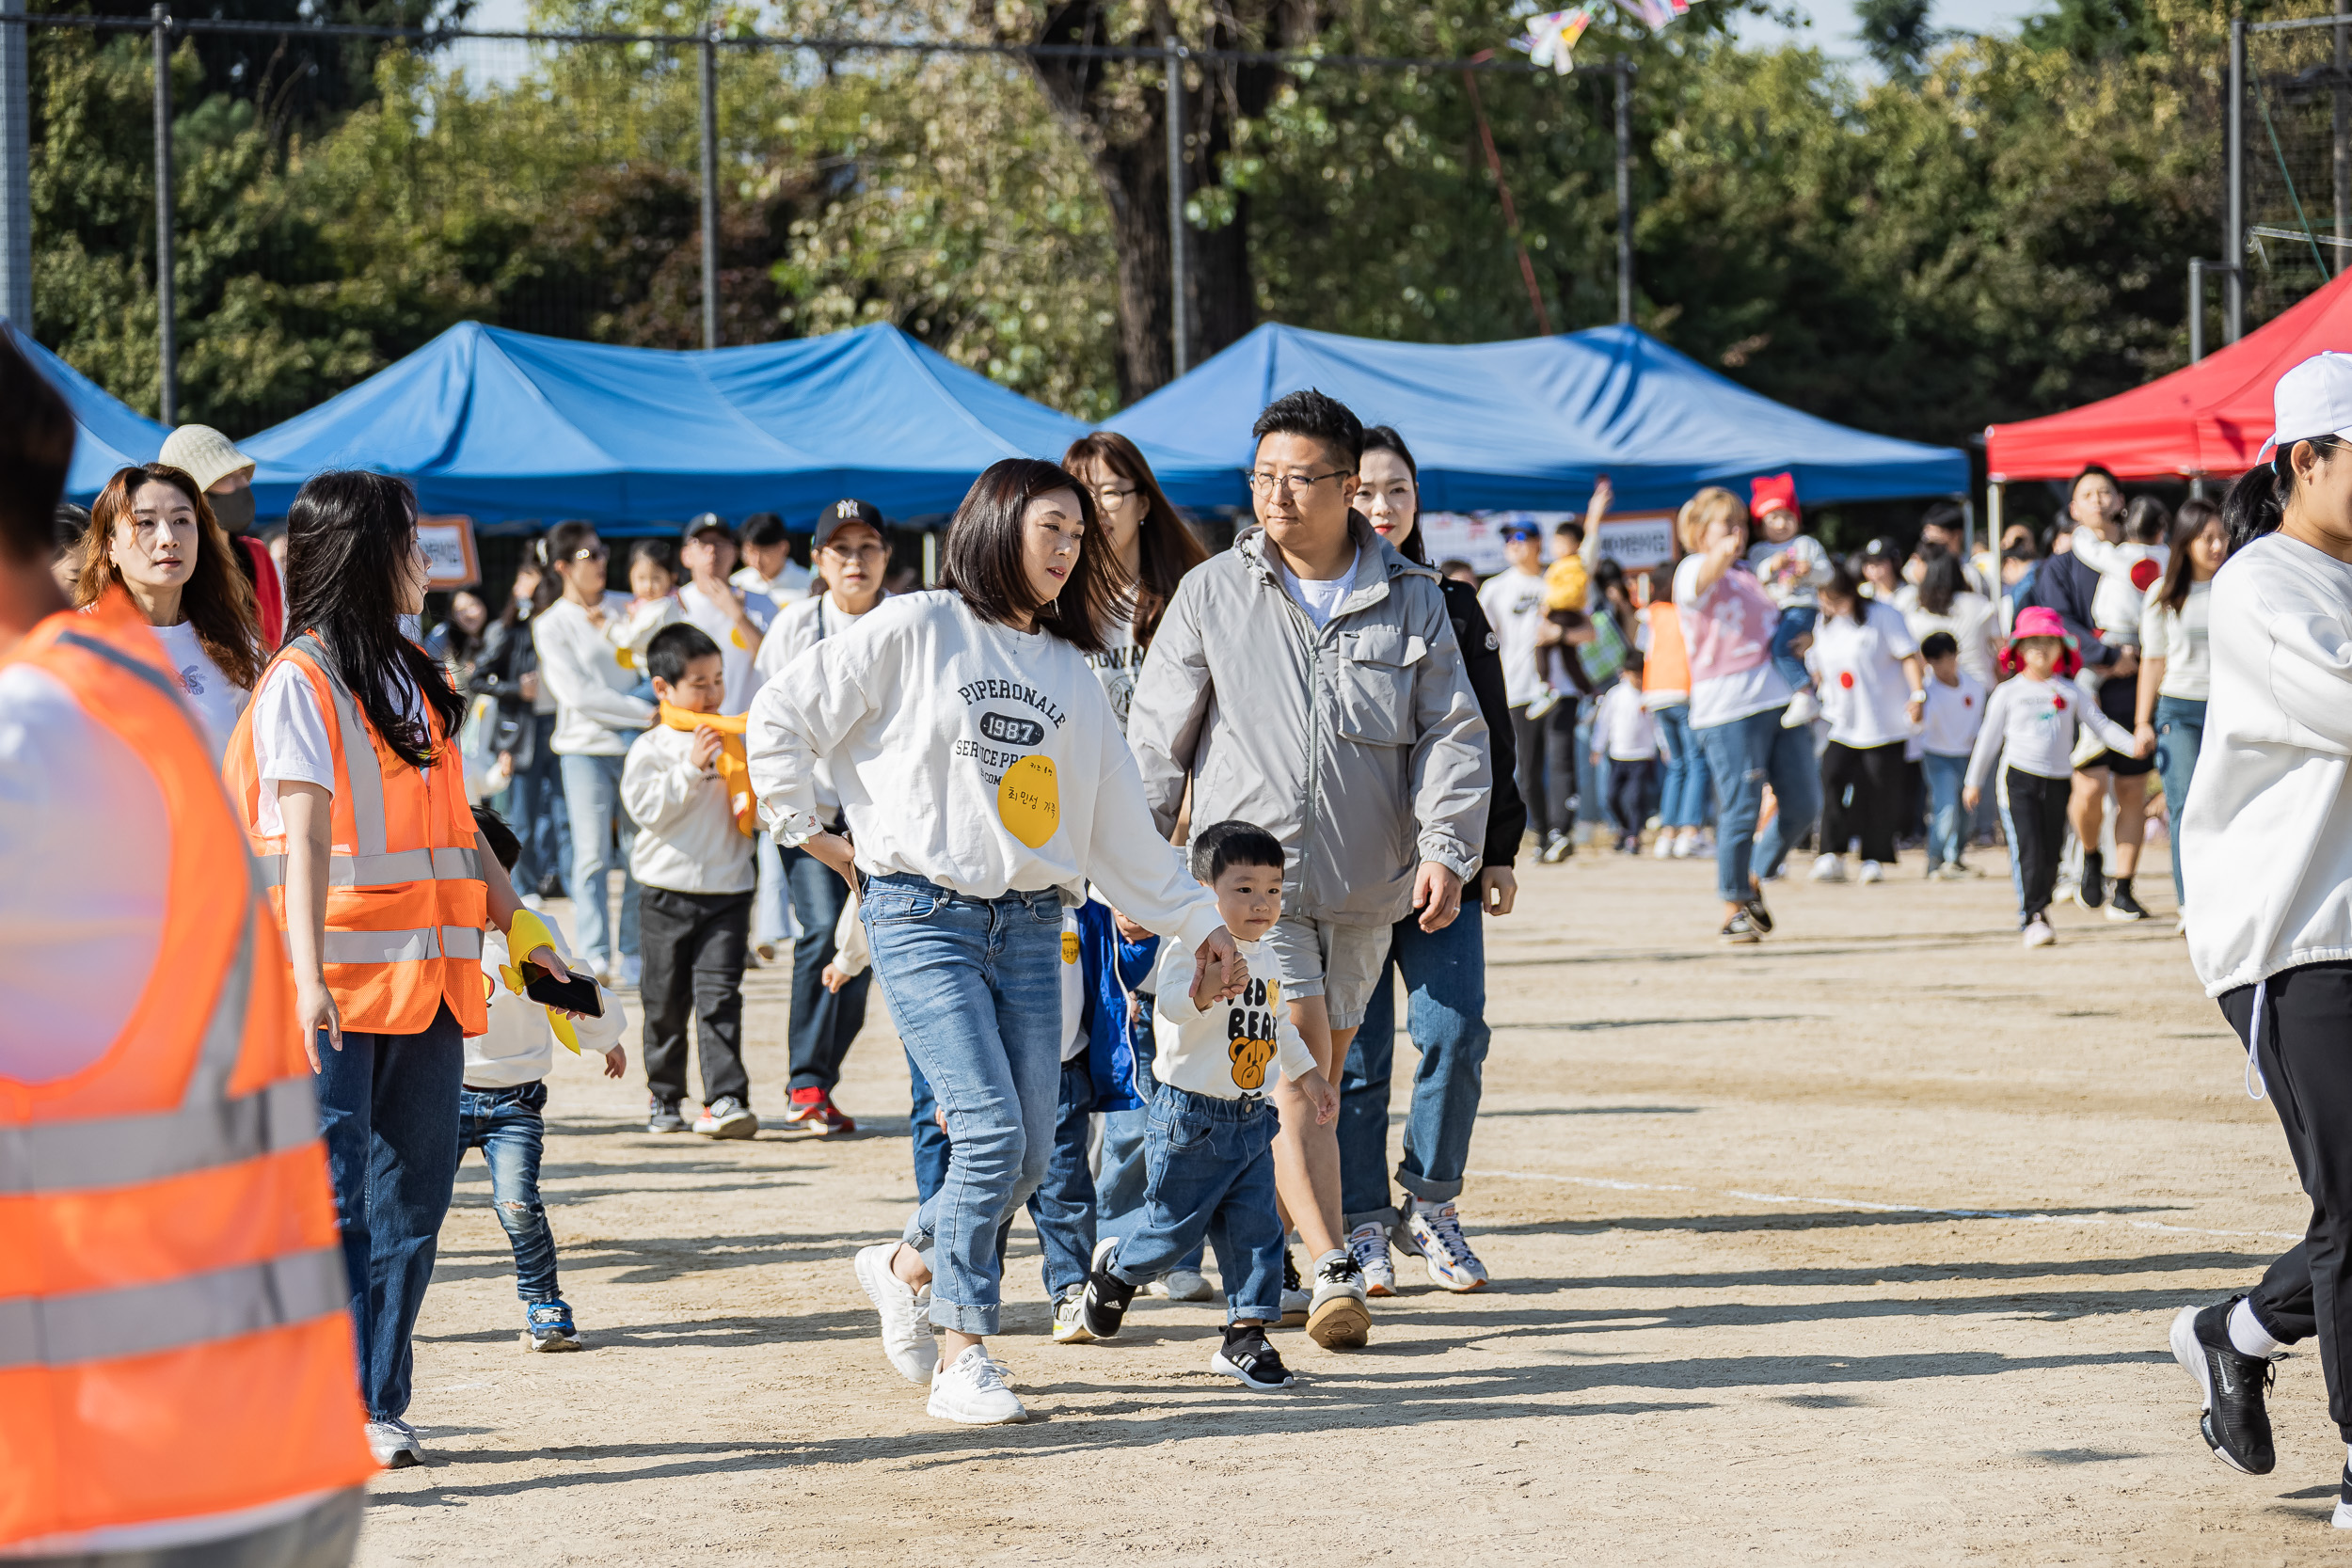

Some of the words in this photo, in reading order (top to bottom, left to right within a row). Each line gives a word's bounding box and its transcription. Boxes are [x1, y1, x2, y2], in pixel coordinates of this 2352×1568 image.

[836, 499, 859, 519] NY
[958, 679, 1066, 730] PIPERONALE
[988, 716, 1035, 742] 1987
[999, 752, 1026, 768] PR
[1227, 1007, 1278, 1043] BEAR
